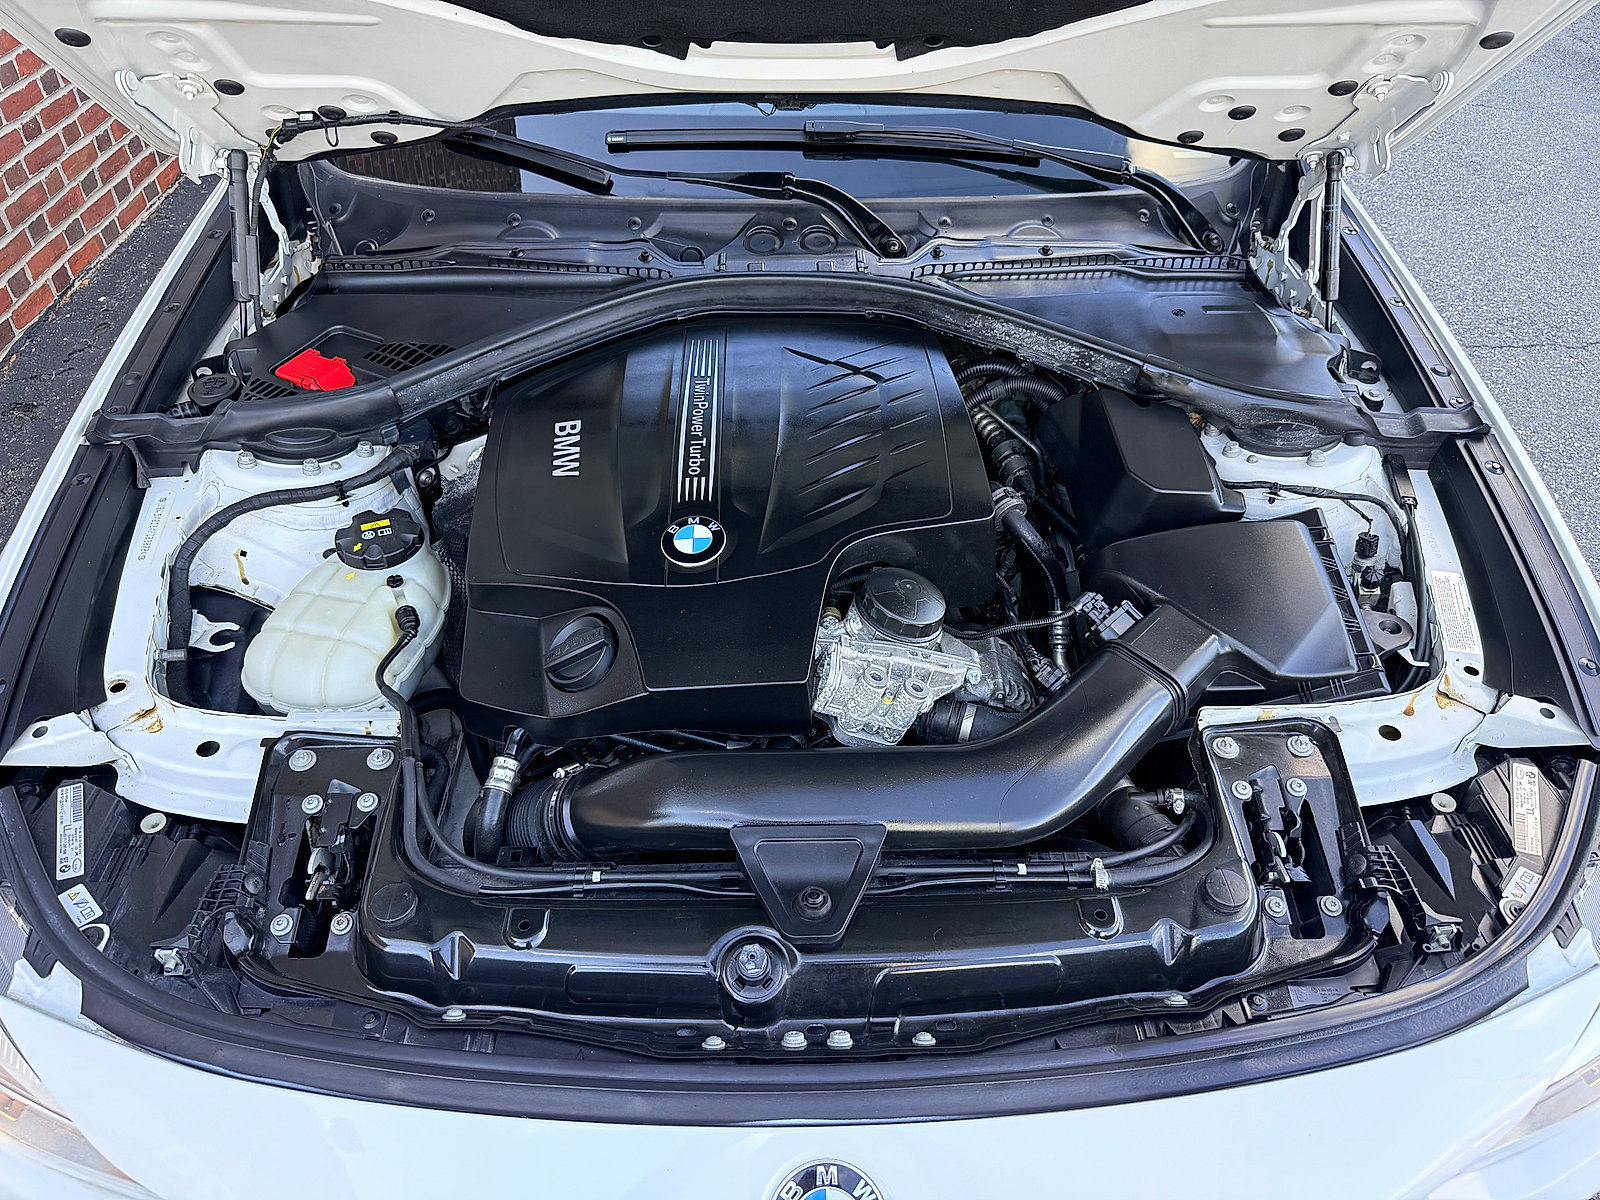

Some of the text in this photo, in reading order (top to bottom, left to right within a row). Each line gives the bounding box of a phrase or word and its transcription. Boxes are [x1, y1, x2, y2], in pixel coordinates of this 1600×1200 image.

[552, 419, 582, 477] BMW
[667, 517, 720, 535] BMW
[779, 1165, 877, 1200] BMW
